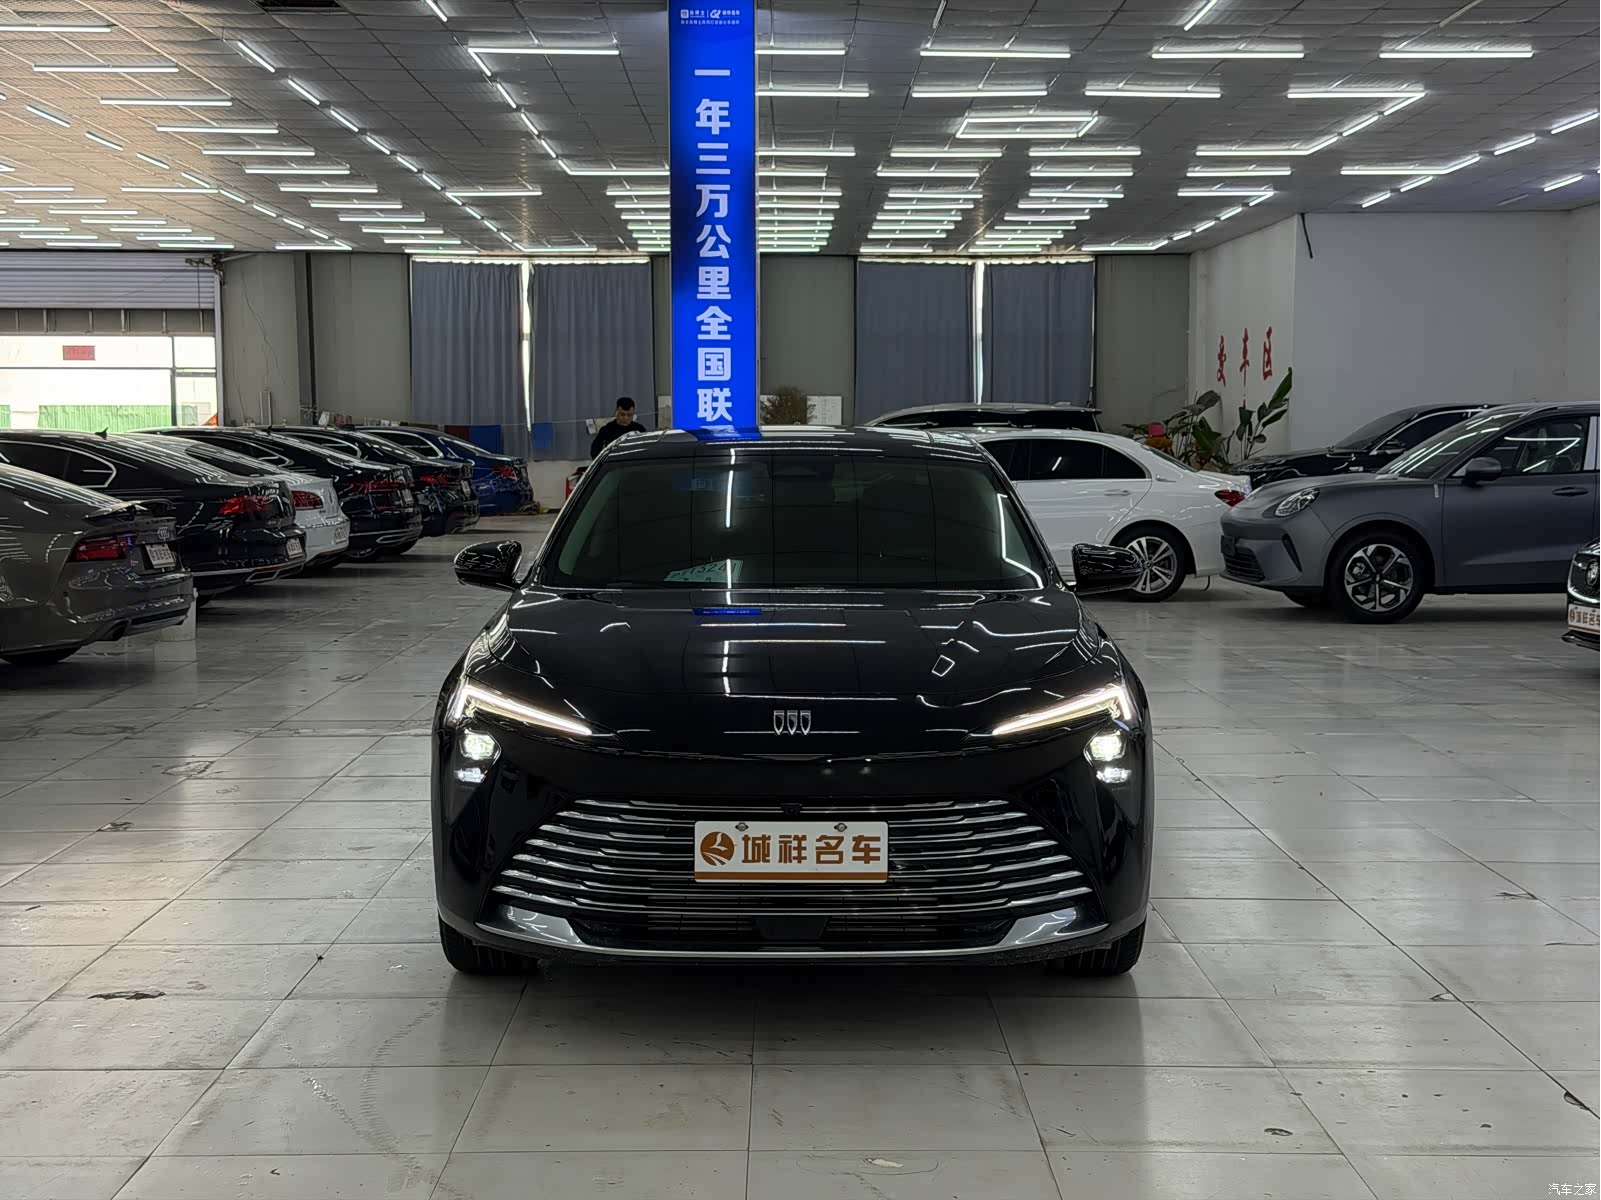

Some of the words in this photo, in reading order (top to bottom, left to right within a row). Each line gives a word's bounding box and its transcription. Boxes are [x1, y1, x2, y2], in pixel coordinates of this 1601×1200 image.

[694, 69, 733, 422] 一年三万公里全国联
[741, 834, 881, 865] 城祥名车
